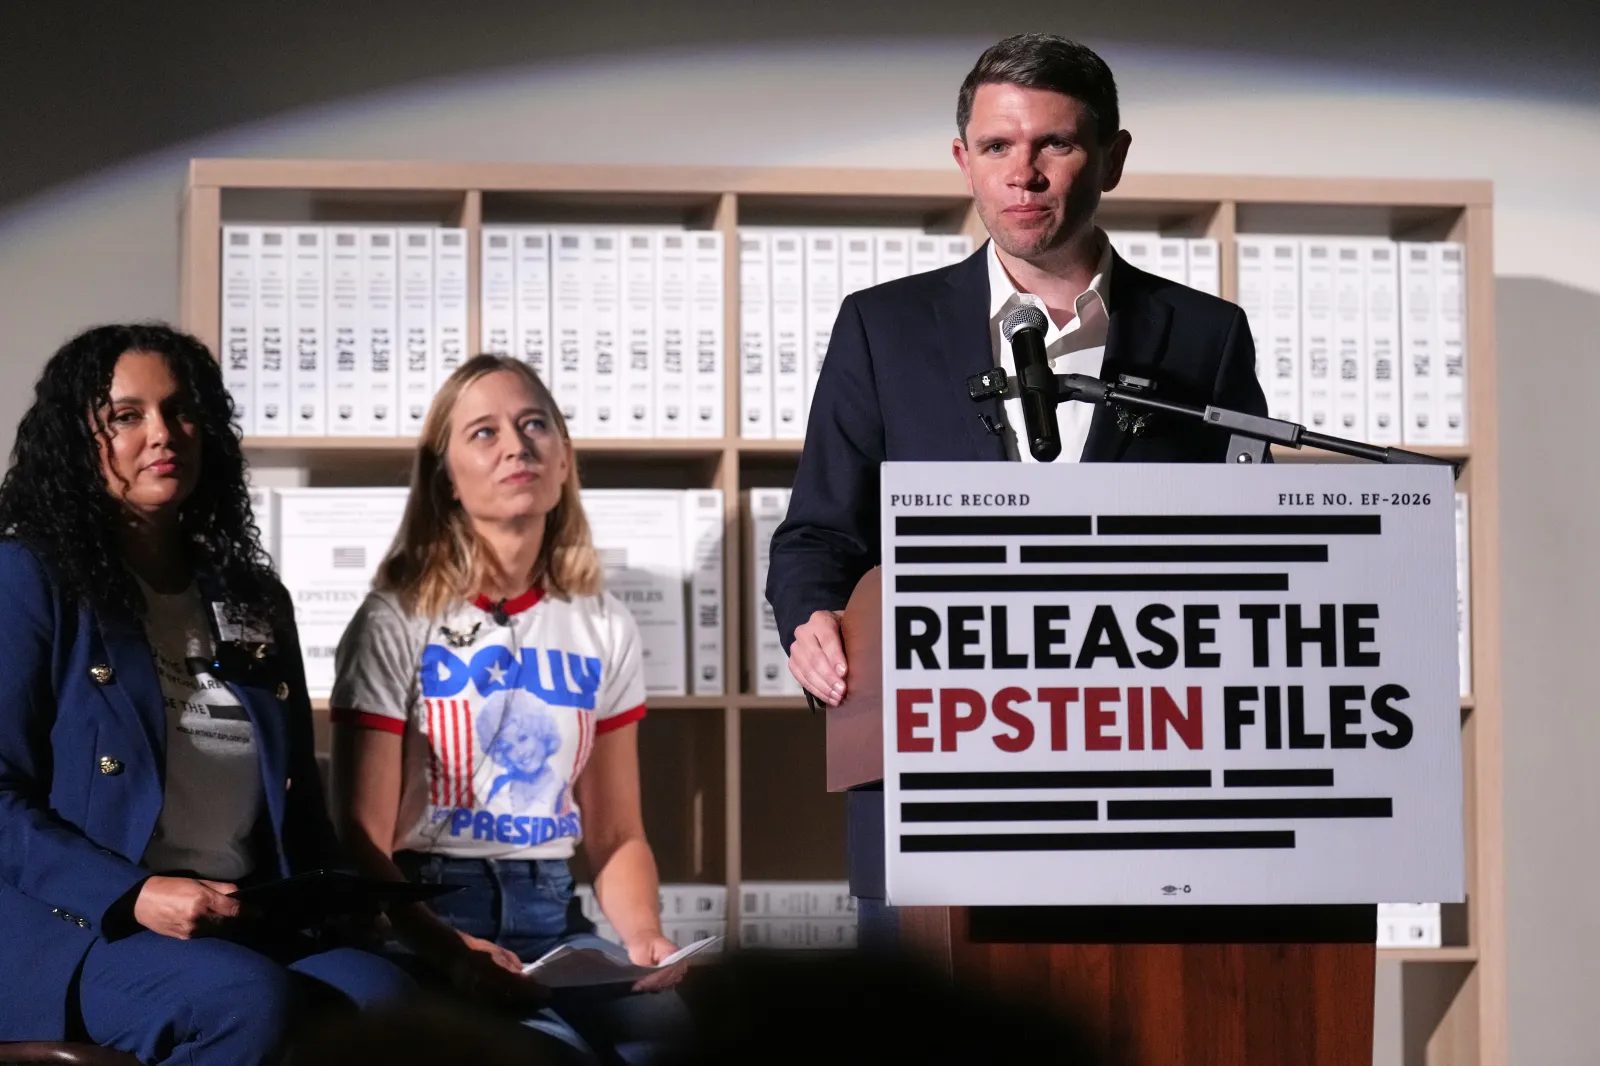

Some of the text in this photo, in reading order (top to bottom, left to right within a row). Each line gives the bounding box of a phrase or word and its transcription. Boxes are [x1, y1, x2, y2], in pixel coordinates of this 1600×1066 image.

[891, 493, 1031, 507] PUBLIC RECORD
[1278, 492, 1432, 506] FILE NO. EF-2026
[895, 603, 1381, 670] RELEASE THE
[420, 644, 602, 710] DOLLY
[180, 700, 207, 715] THE
[896, 683, 1414, 753] EPSTEIN FILES
